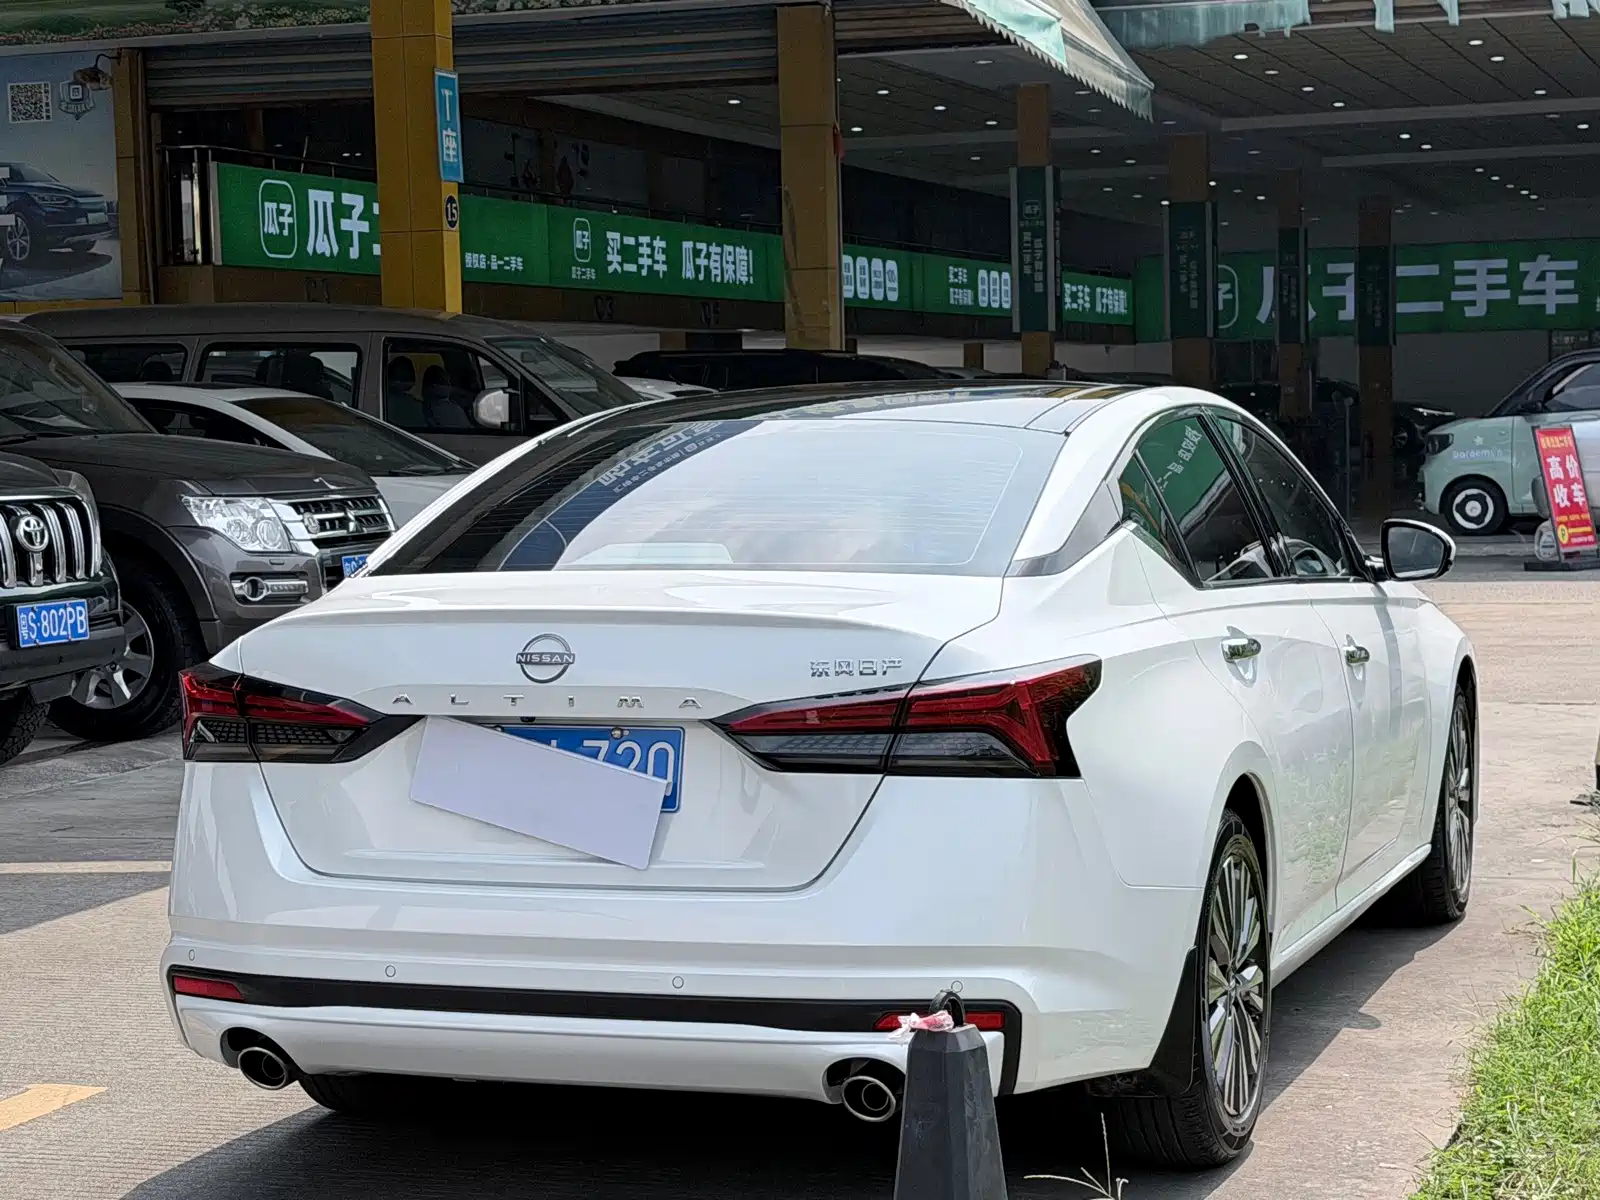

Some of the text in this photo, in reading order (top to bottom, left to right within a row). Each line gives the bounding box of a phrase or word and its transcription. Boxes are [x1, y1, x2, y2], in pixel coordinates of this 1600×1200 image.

[263, 201, 294, 236] 瓜子
[306, 188, 380, 260] 瓜子
[446, 202, 457, 222] 15
[606, 231, 754, 285] 买二手车 瓜子有保障!
[1546, 453, 1579, 480] 高价
[1553, 482, 1586, 508] 收车
[516, 652, 575, 665] NISSAN
[810, 657, 904, 678] 东风日产
[392, 693, 704, 710] ALTIMA
